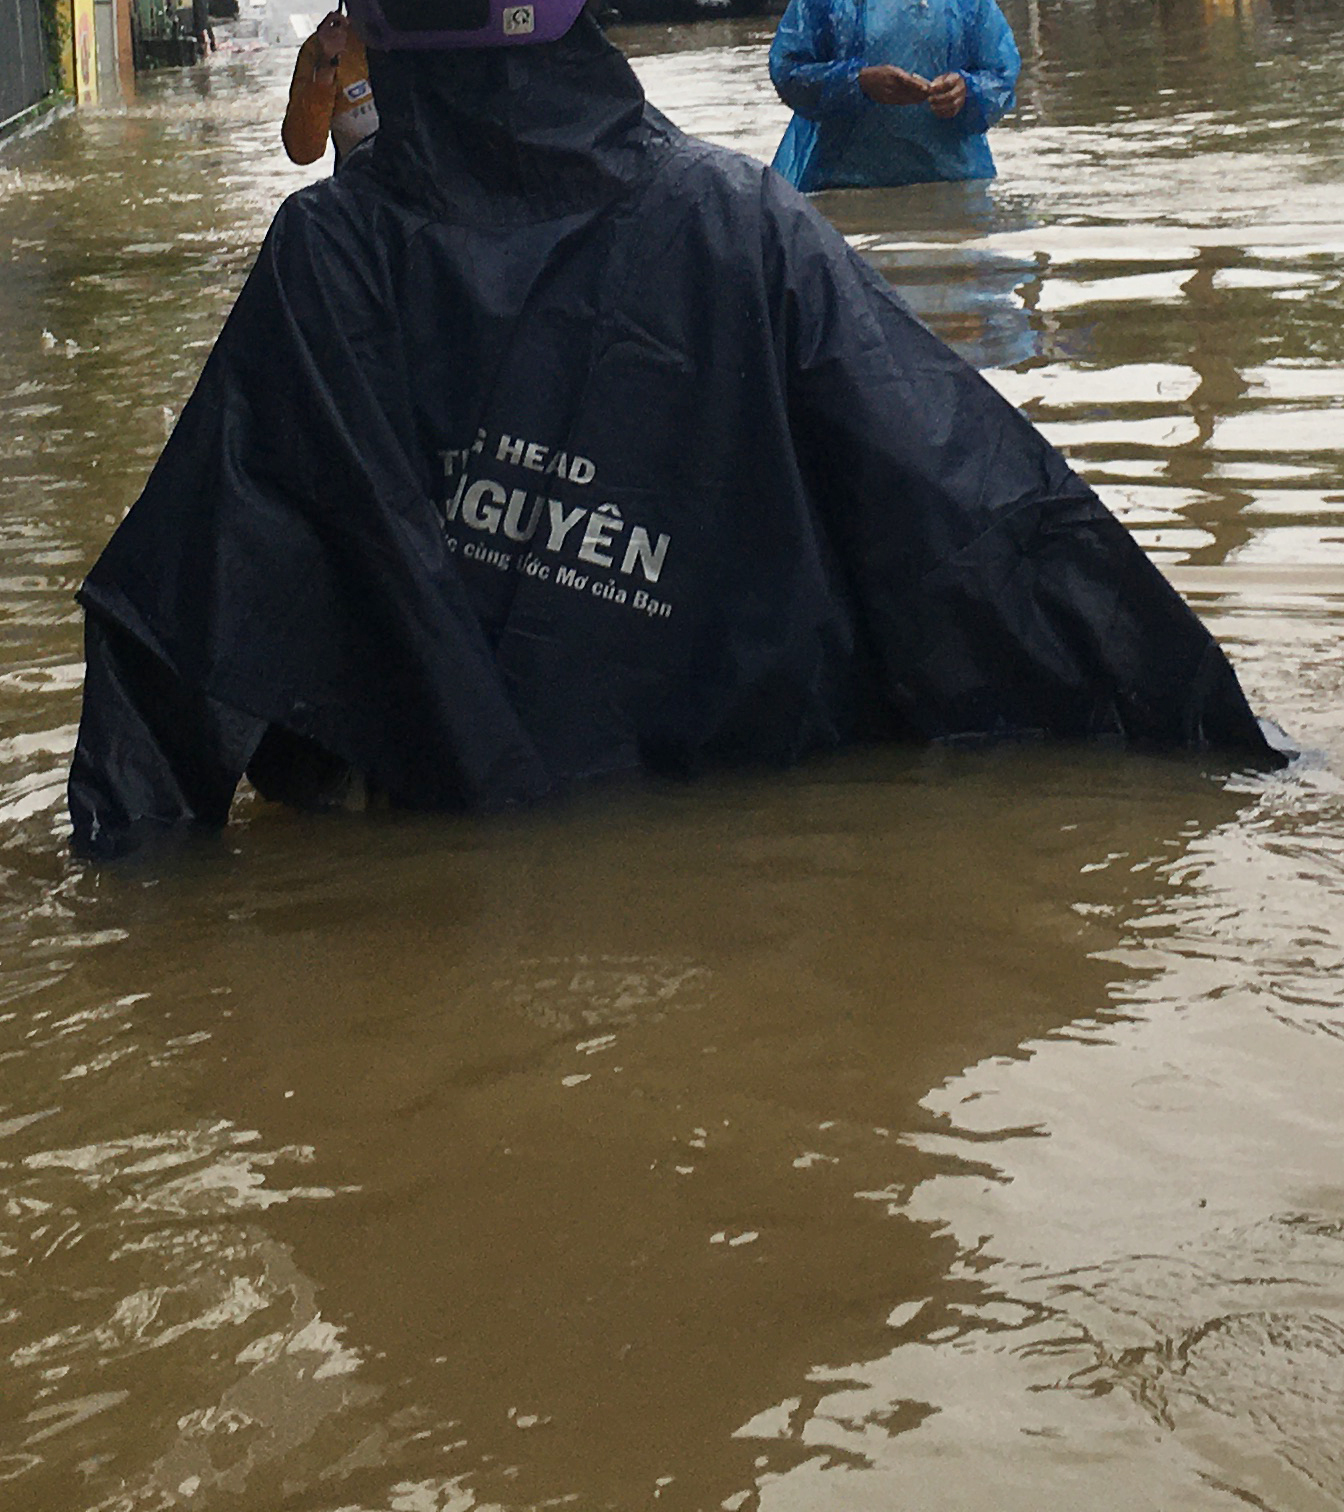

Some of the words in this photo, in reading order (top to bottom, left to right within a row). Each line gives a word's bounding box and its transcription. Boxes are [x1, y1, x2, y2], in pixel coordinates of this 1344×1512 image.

[495, 434, 597, 486] HEAD
[555, 565, 590, 592] Mơ
[592, 577, 628, 606] của
[632, 589, 674, 619] Bạn
